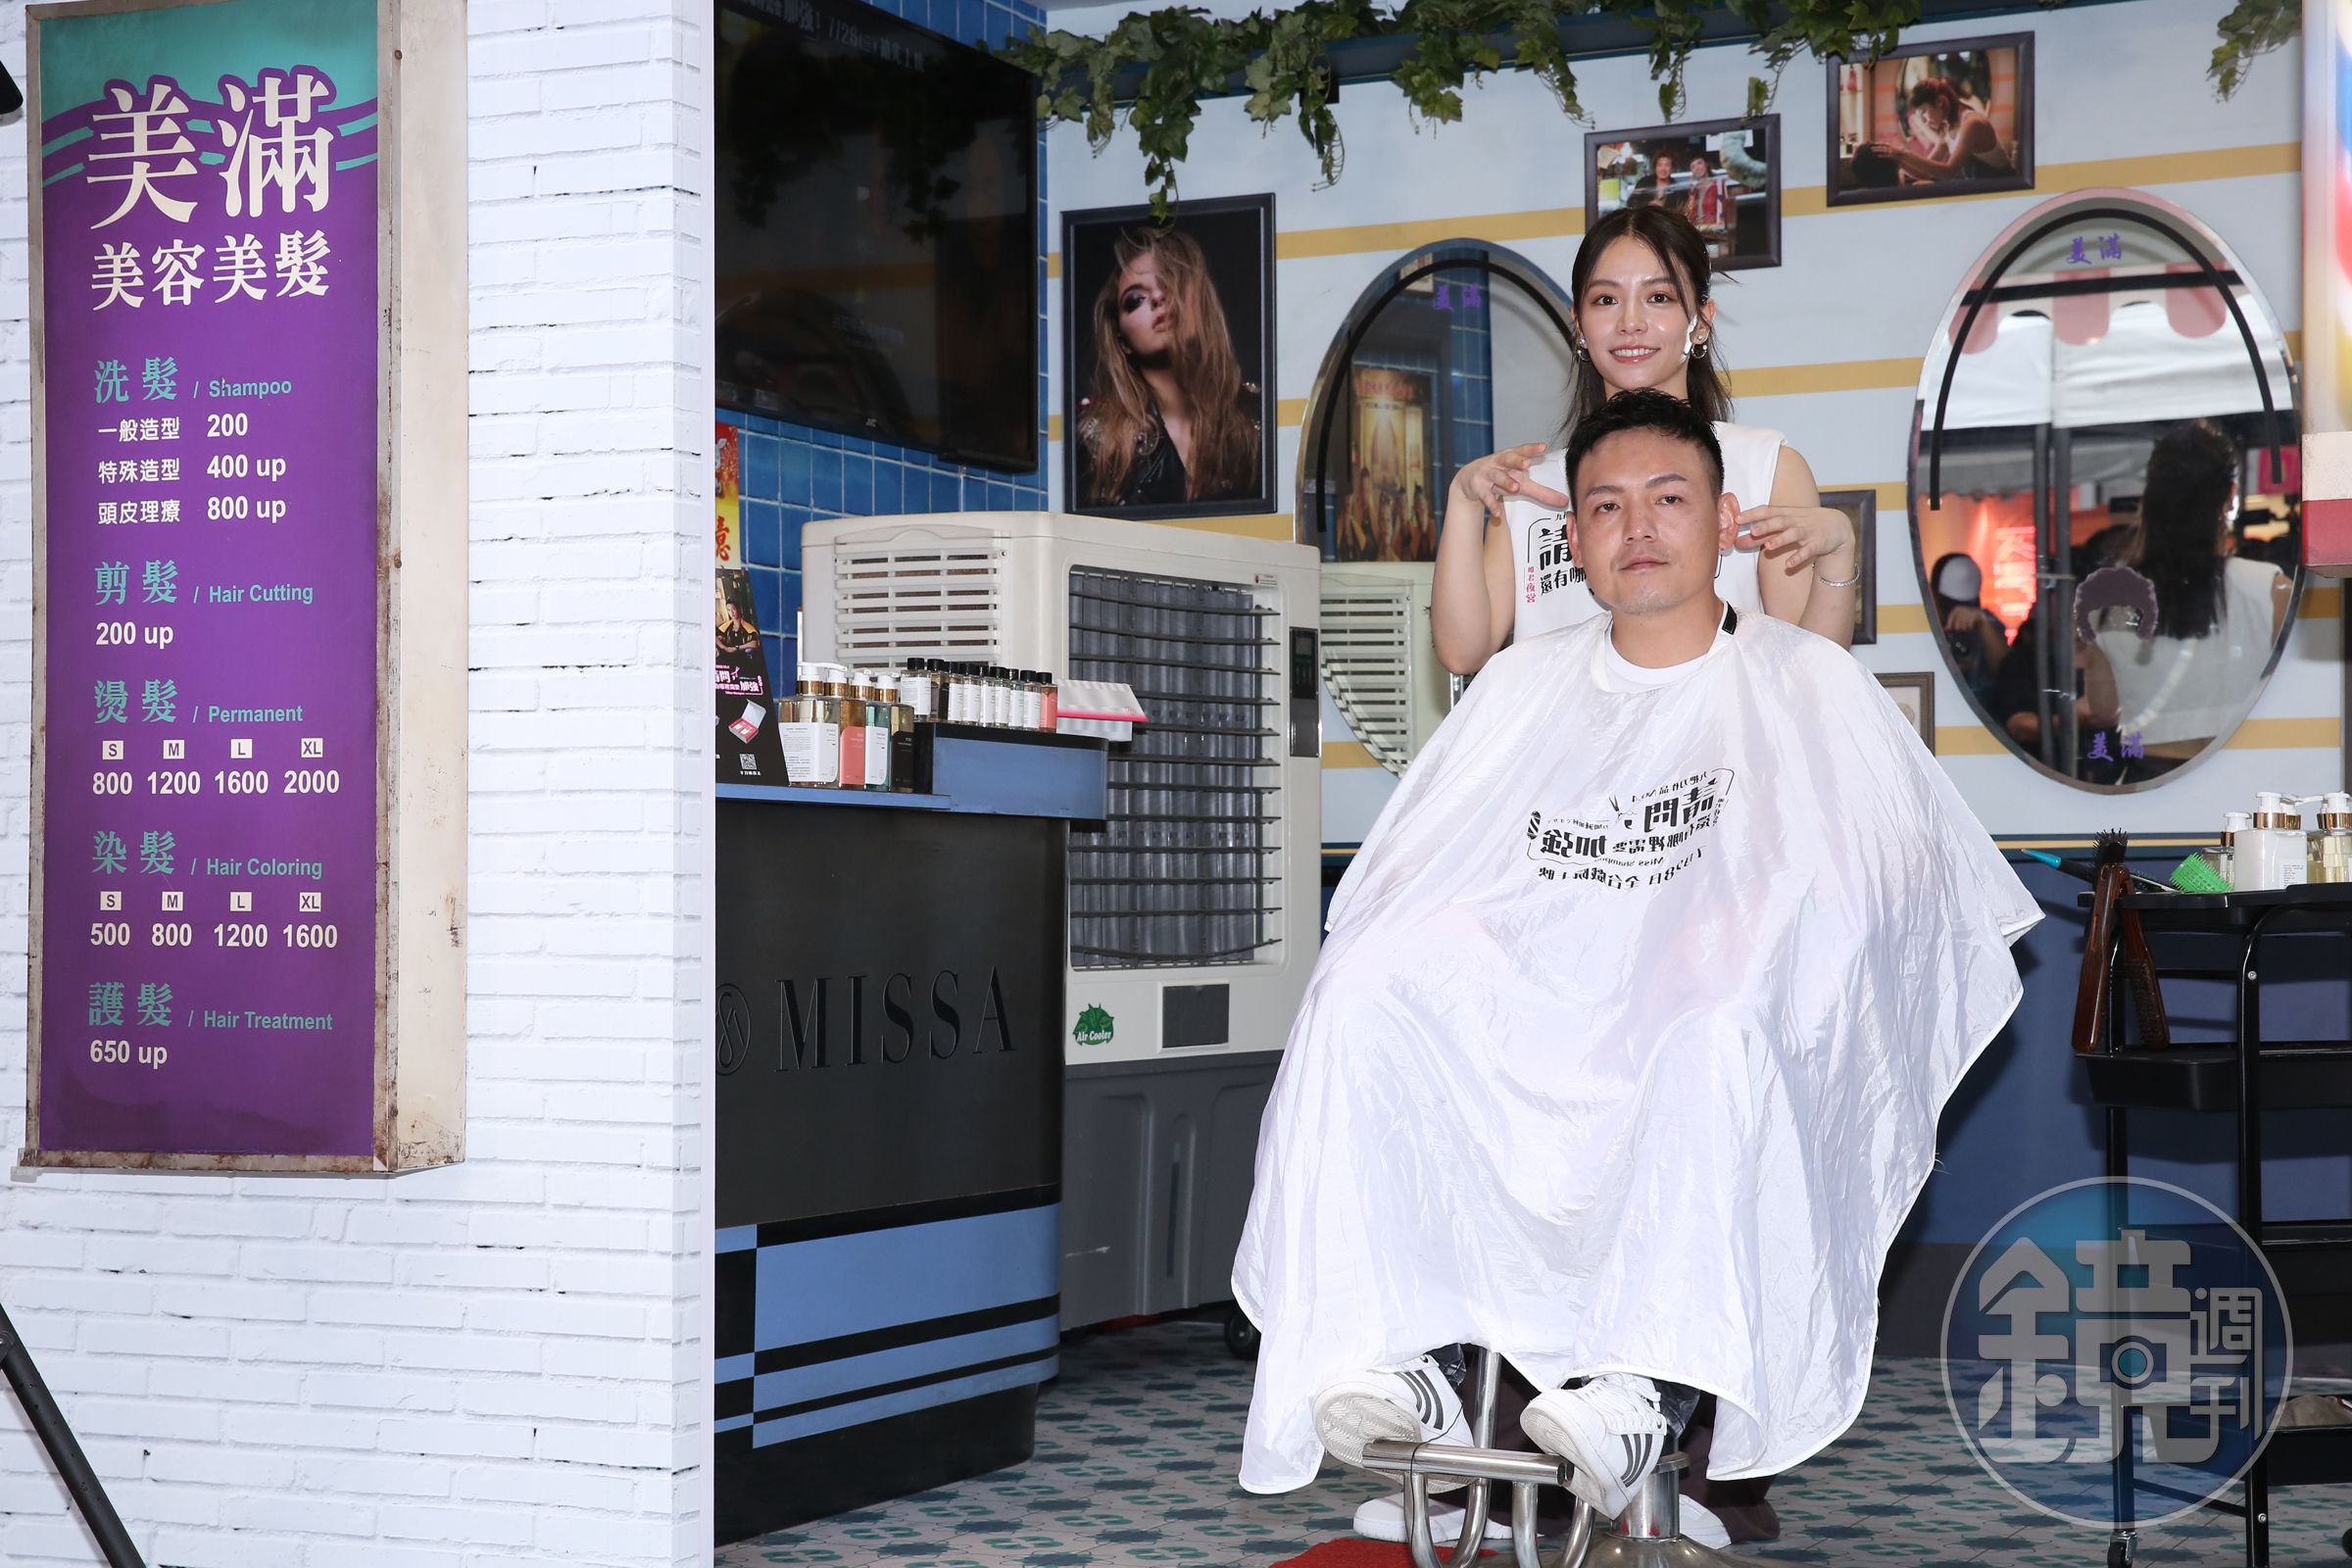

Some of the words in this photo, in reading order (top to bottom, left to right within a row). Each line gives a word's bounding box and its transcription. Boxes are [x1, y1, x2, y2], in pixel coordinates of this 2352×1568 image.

[86, 74, 334, 229] 美滿
[2067, 232, 2122, 265] 美滿
[91, 229, 330, 311] 美容美髮
[95, 357, 177, 403] 洗髮
[209, 378, 292, 399] Shampoo
[98, 416, 180, 442] 一般造型
[207, 413, 248, 437] 200
[98, 458, 180, 484] 特殊造型
[207, 454, 248, 478] 400
[257, 459, 286, 481] up
[98, 499, 180, 524] 頭皮理療
[208, 496, 248, 520] 800
[257, 500, 286, 523] up
[95, 560, 178, 605] 剪髮
[210, 585, 245, 603] Hair
[250, 584, 313, 605] Cutting
[96, 621, 136, 645] 200
[145, 626, 173, 650] up
[94, 679, 177, 723] 燙髮
[209, 706, 303, 722] Permanent
[109, 744, 117, 757] S
[169, 743, 178, 756] M
[238, 743, 245, 755] L
[304, 742, 320, 755] XL
[2086, 731, 2145, 762] 美滿
[93, 772, 132, 795] 800
[148, 771, 200, 794] 1200
[215, 770, 269, 794] 1600
[283, 770, 339, 793] 2000
[93, 831, 176, 874] 染髮
[207, 858, 242, 875] Hair
[247, 858, 321, 880] Coloring
[107, 895, 115, 907] S
[168, 895, 177, 907] M
[238, 896, 245, 908] L
[302, 896, 318, 908] XL
[90, 923, 130, 946] 500
[152, 923, 192, 946] 800
[214, 923, 268, 947] 1200
[283, 924, 337, 948] 1600
[89, 982, 172, 1026] 護髮
[205, 1011, 239, 1027] Hair
[244, 1011, 332, 1030] Treatment
[774, 964, 1016, 1072] MISSA
[1076, 1031, 1088, 1042] Air
[1089, 1030, 1112, 1041] Cooler
[90, 1040, 129, 1063] 650
[139, 1047, 167, 1069] up
